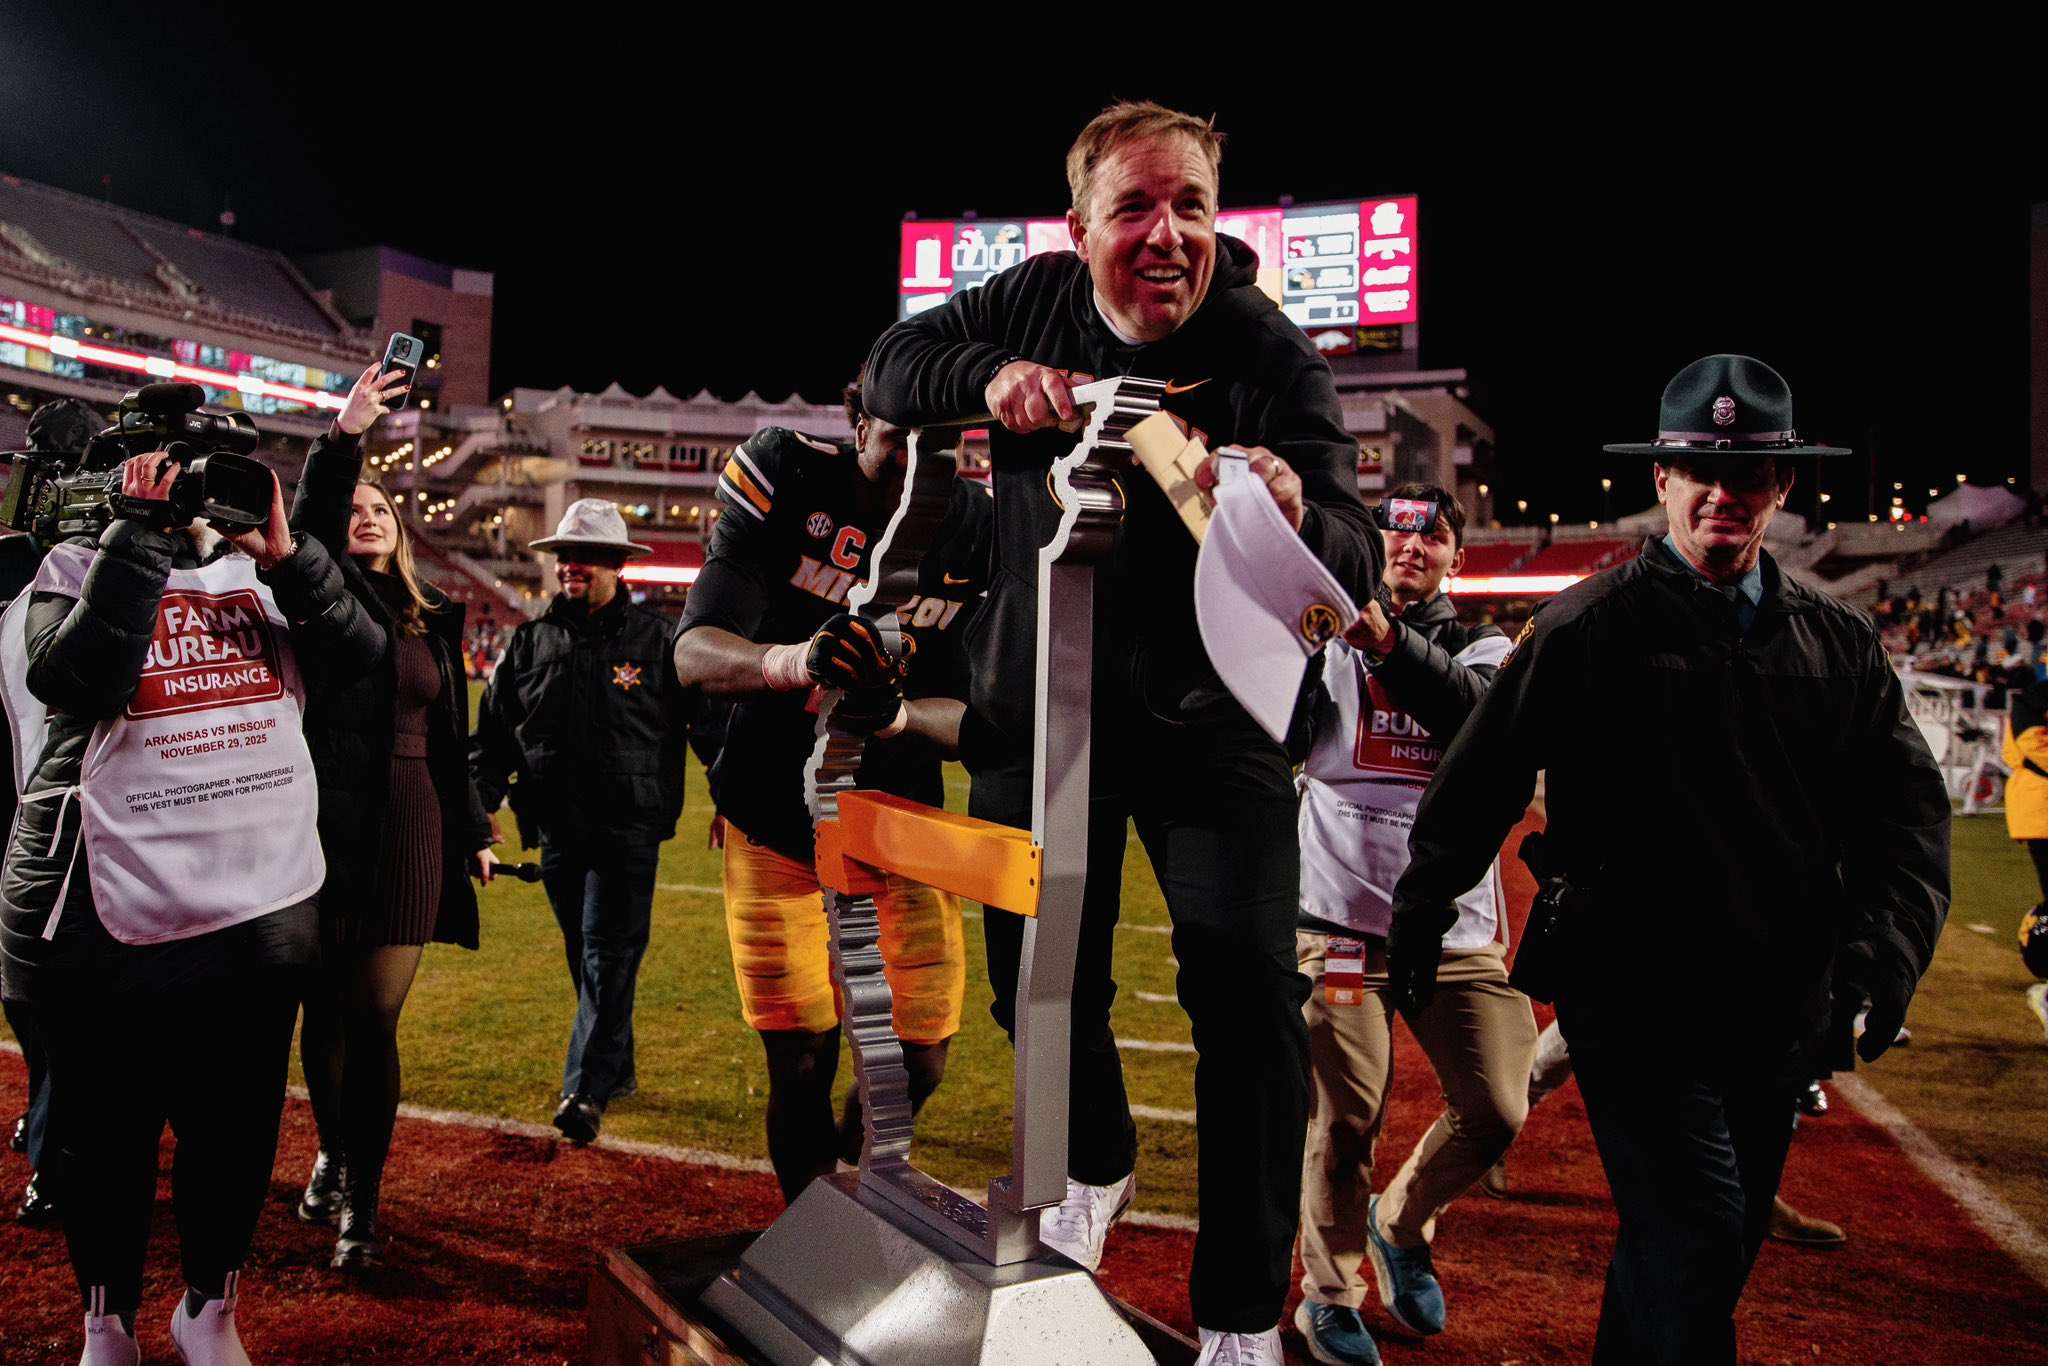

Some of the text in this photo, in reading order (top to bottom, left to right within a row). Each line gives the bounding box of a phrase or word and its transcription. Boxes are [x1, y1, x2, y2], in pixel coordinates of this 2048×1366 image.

[808, 514, 832, 536] SEC
[831, 526, 867, 570] C
[163, 605, 253, 635] FARM
[164, 667, 270, 697] INSURANCE
[144, 718, 276, 748] ARKANSAS VS MISSOURI
[160, 733, 267, 760] NOVEMBER 29, 2025
[126, 790, 163, 804] OFFICIAL
[164, 779, 230, 797] PHOTOGRAPHER
[235, 765, 294, 785] NONTRANSFERABLE
[129, 776, 293, 814] THIS VEST MUST BE WORN FOR PHOTO ACCESS
